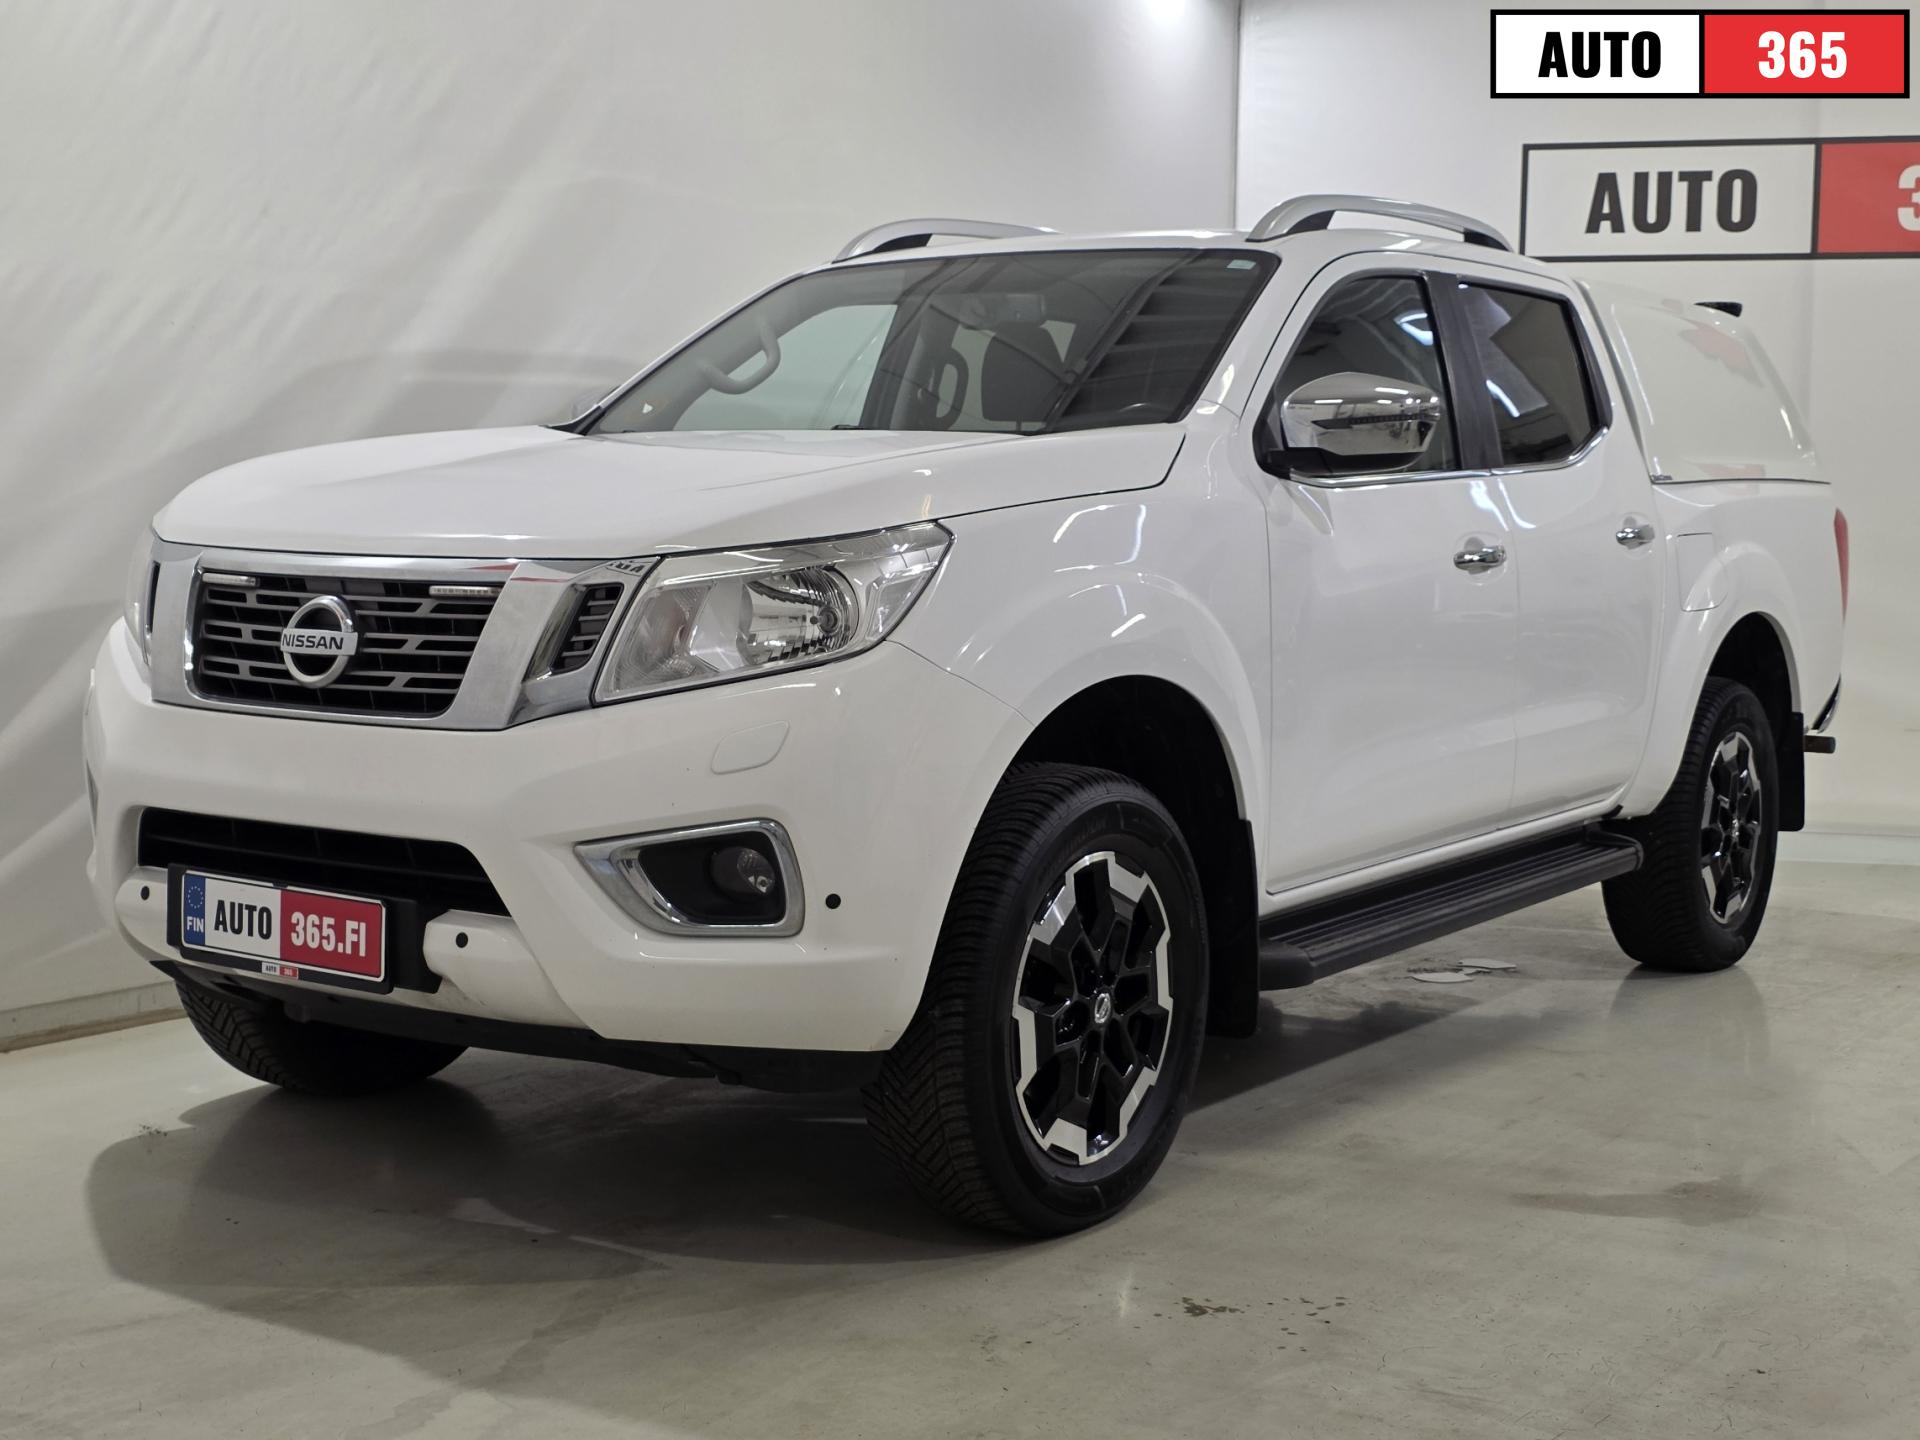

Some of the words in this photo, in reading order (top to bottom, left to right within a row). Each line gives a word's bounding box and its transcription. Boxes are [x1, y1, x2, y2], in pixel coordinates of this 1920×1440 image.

[1585, 169, 1757, 233] AUTO
[282, 634, 344, 650] NISSAN
[186, 916, 204, 932] FIN
[214, 899, 272, 940] AUTO
[290, 911, 366, 957] 365.FI
